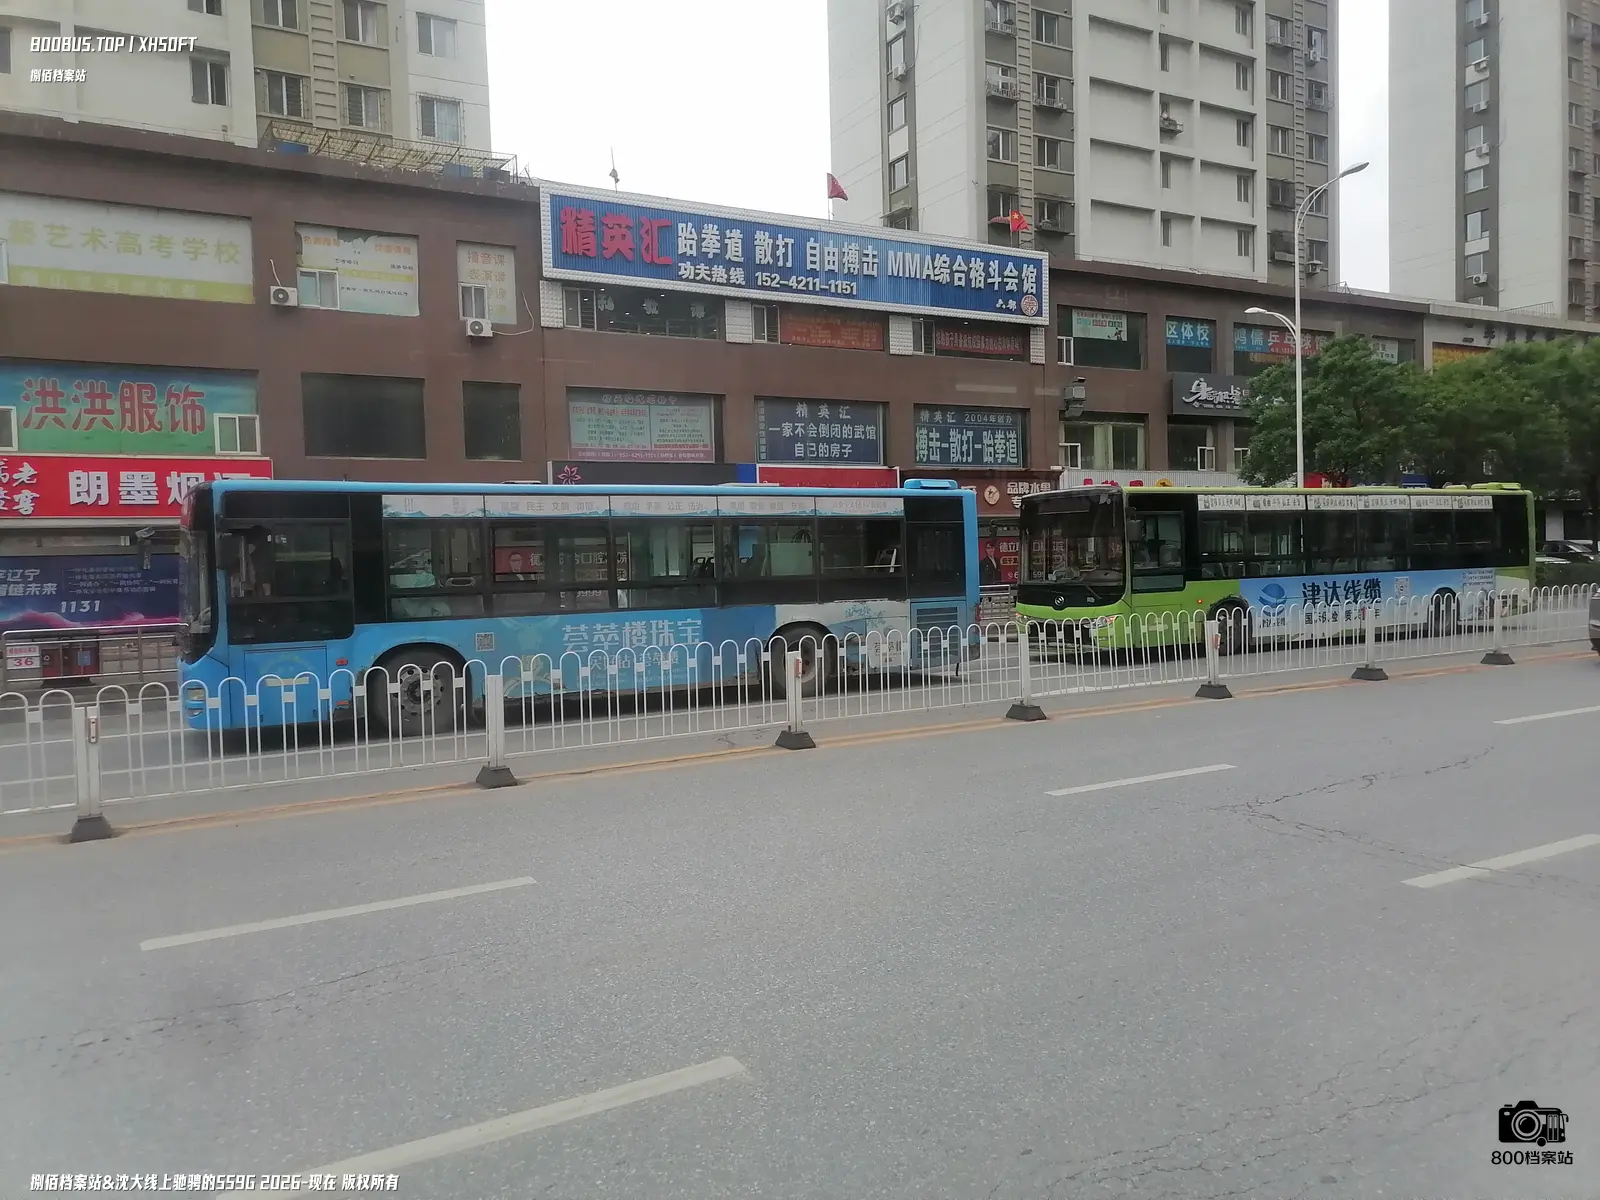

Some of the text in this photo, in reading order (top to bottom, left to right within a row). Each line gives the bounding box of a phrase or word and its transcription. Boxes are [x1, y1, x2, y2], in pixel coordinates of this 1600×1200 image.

[560, 205, 1037, 295] 精英汇 跆拳道 散打 自由搏击 MMA综合格斗会馆
[677, 261, 858, 296] 功夫热线 152-4211-1151
[1166, 320, 1210, 342] 区体校
[20, 377, 207, 435] 洪洪服饰
[795, 401, 853, 420] 精英汇
[919, 408, 957, 423] 精英汇
[768, 421, 877, 440] 一家不会倒闭的武馆
[794, 442, 853, 459] 自己的房子
[1006, 481, 1052, 495] 品牌水果
[1301, 578, 1382, 609] 津达线缆
[60, 600, 101, 614] 1131
[13, 657, 34, 667] 36
